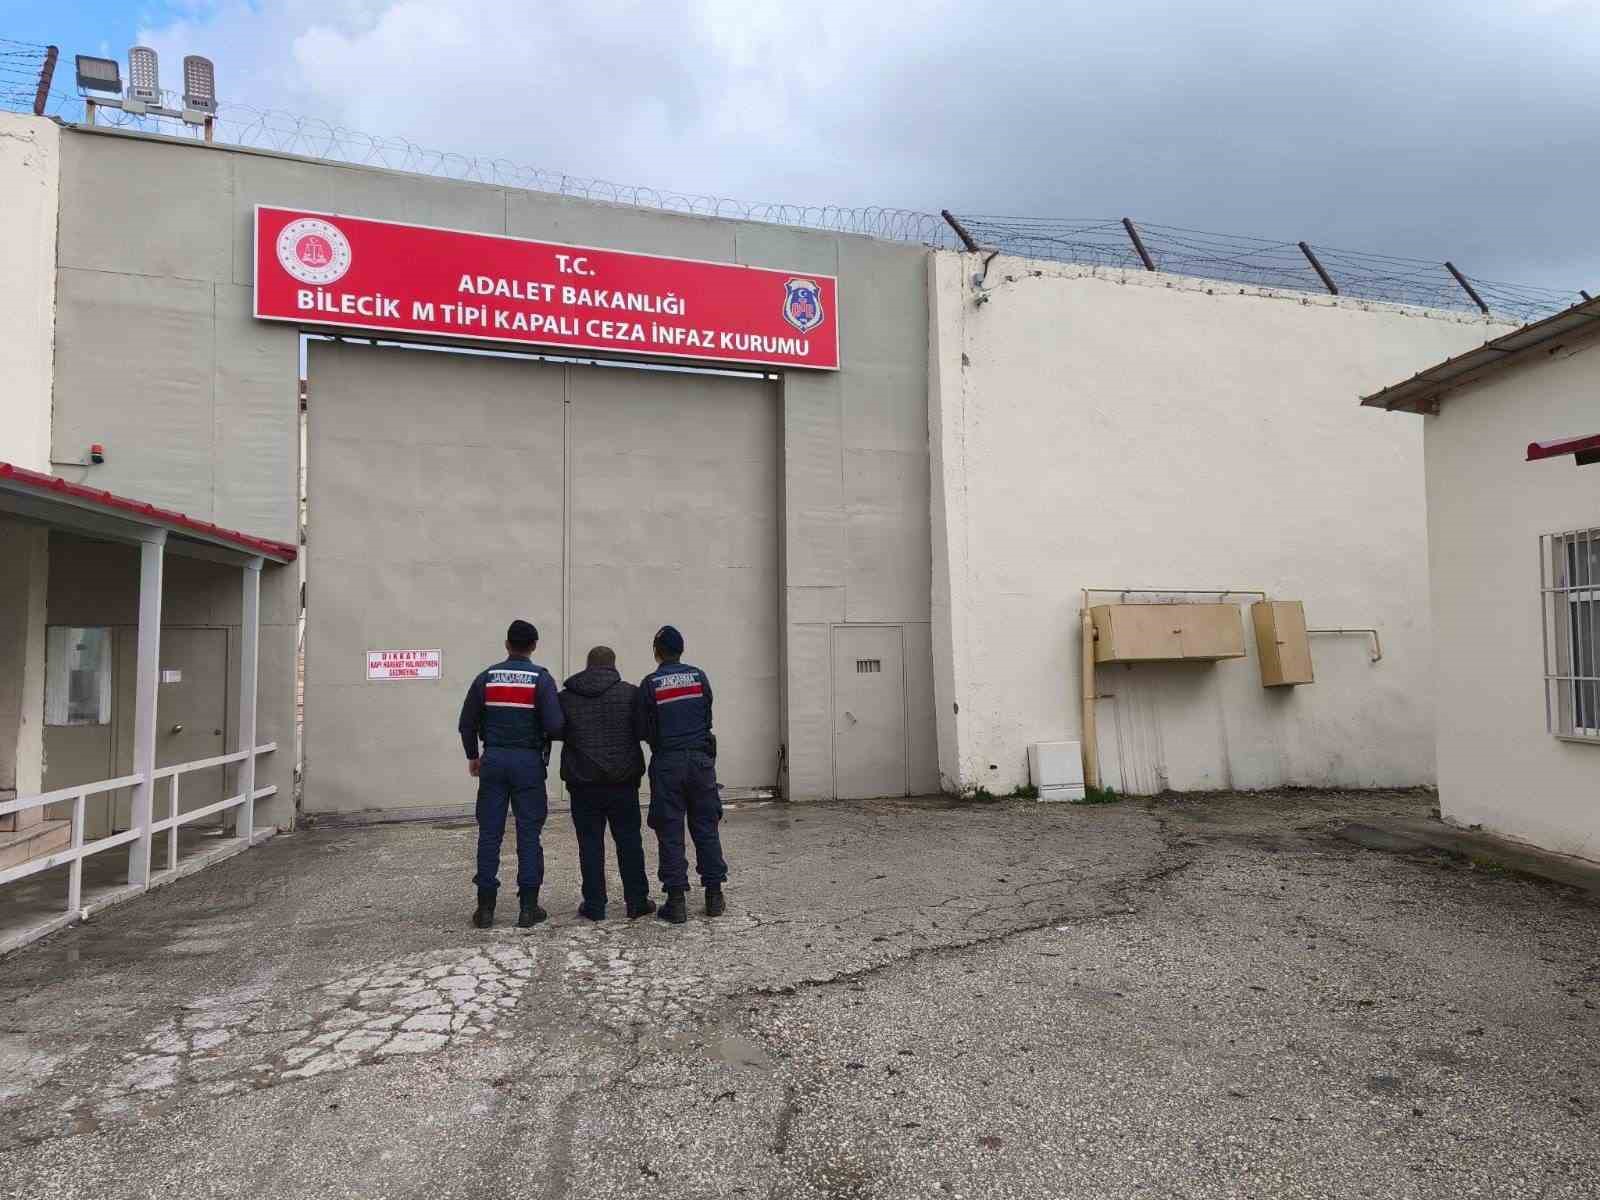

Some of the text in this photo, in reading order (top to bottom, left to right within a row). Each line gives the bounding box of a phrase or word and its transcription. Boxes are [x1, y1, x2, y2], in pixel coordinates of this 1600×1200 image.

[555, 254, 595, 276] T.C.
[458, 274, 686, 316] ADALET BAKANLIĞI
[297, 287, 809, 356] BİLECİK M TİPİ KAPALI CEZA İNFAZ KURUMU
